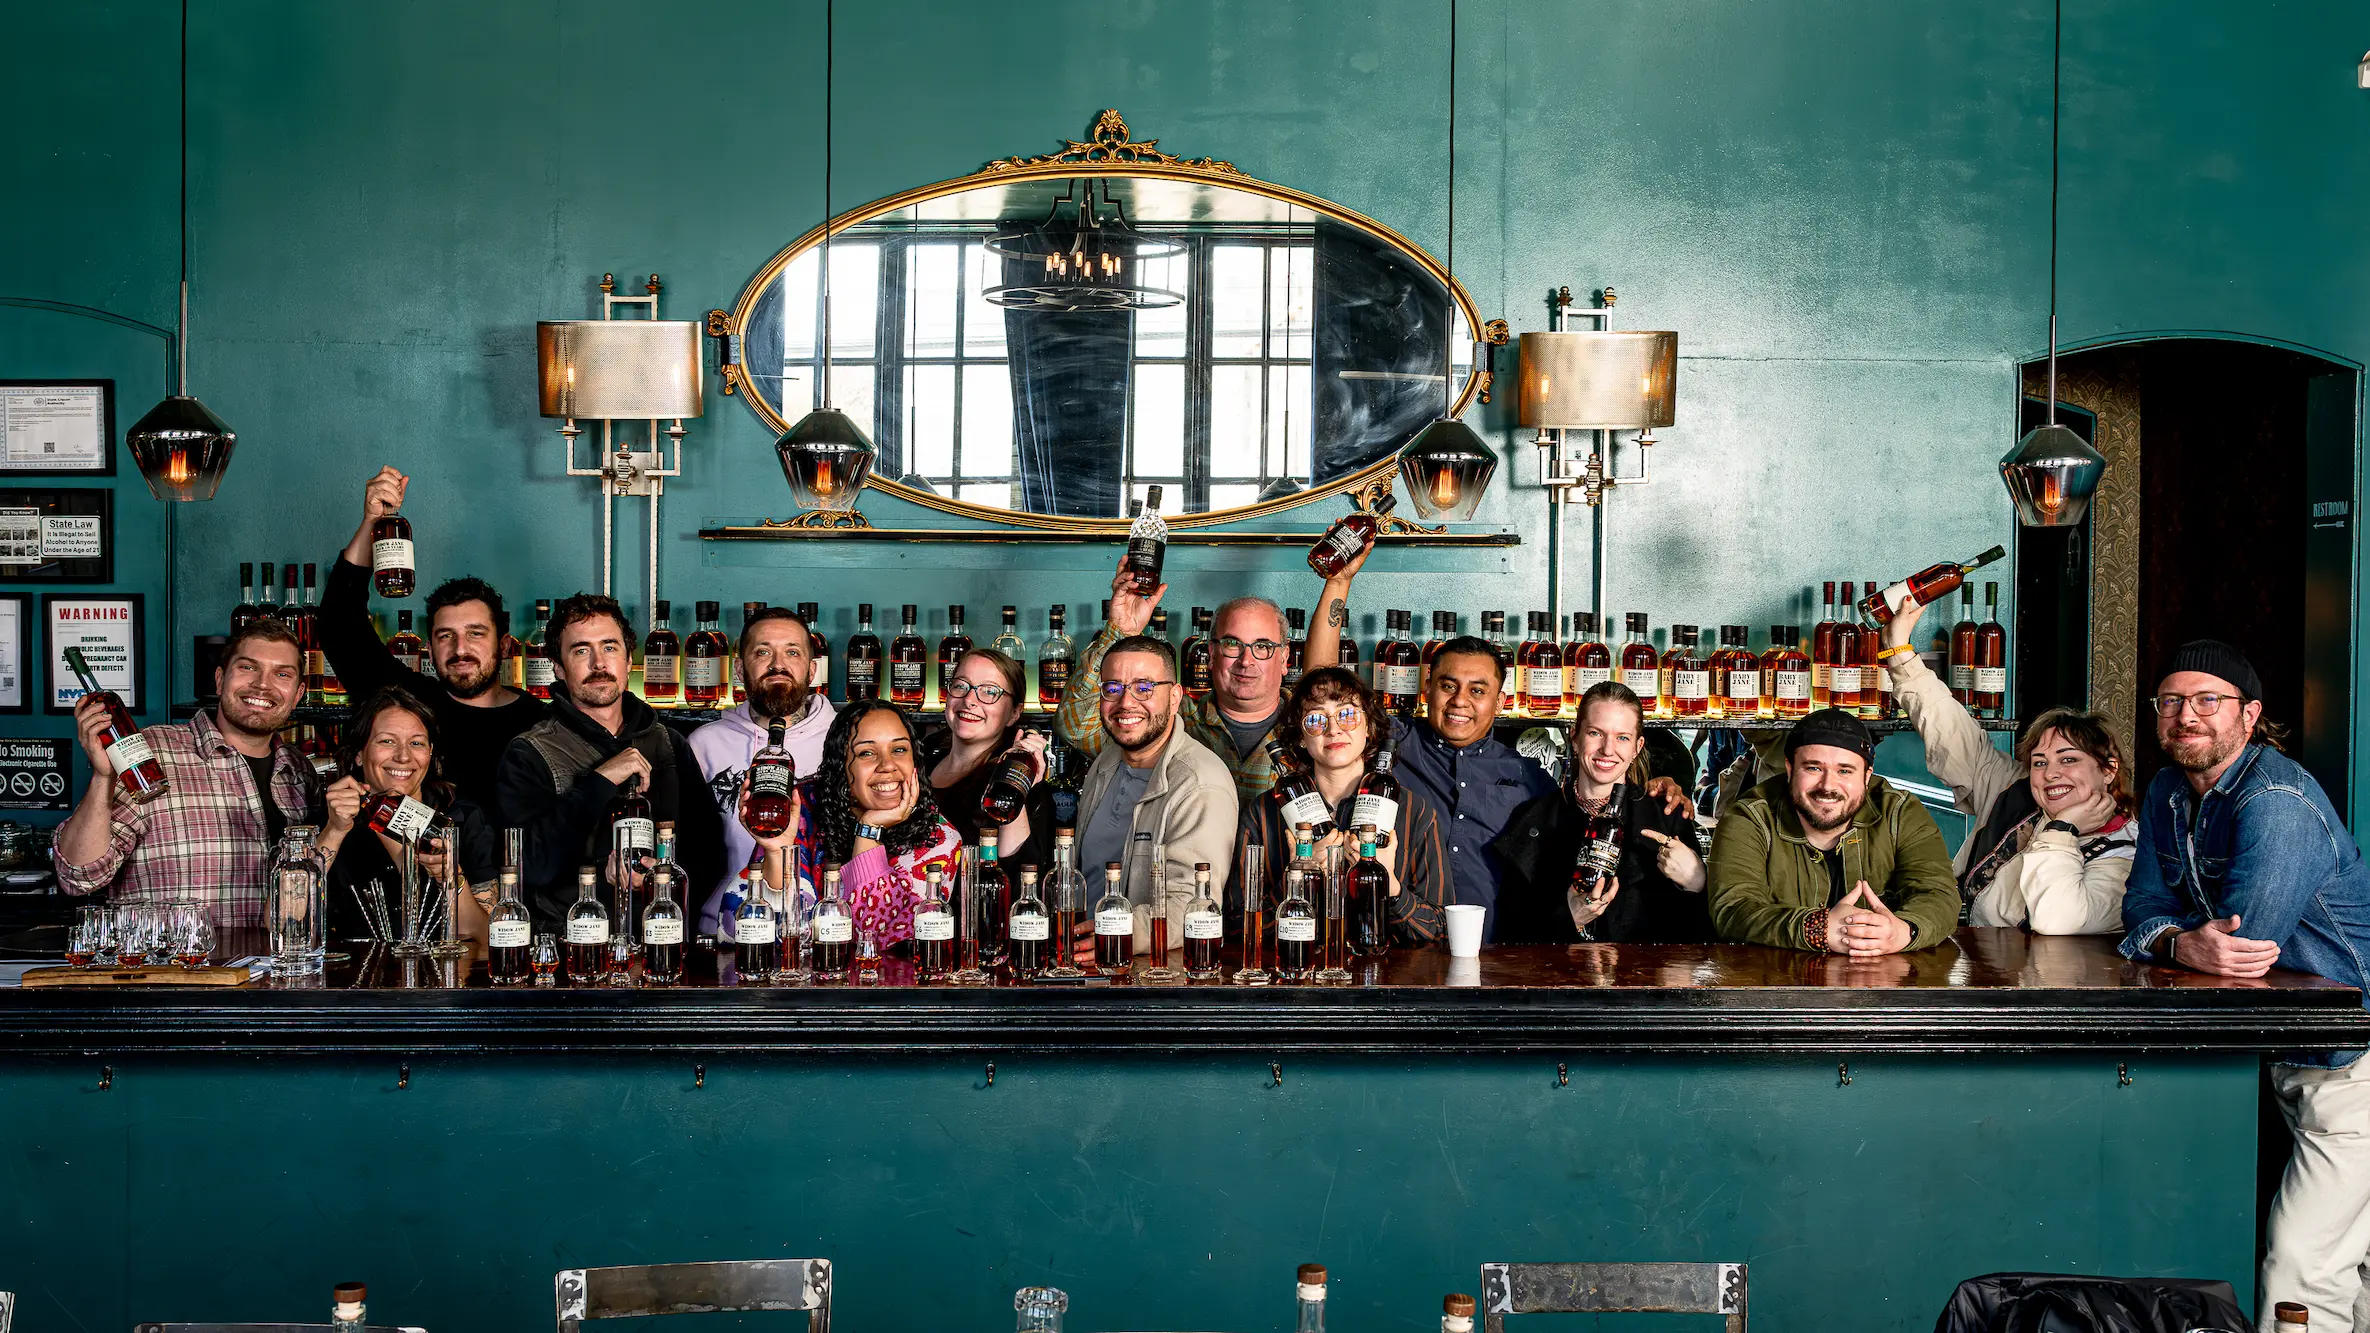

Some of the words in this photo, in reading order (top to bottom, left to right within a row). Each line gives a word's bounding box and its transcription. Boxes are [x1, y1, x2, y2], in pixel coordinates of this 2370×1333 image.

[2313, 500, 2348, 517] RESTROOM
[50, 520, 72, 528] State
[75, 520, 93, 528] Law
[59, 608, 128, 620] WARNING
[0, 745, 8, 756] o
[10, 744, 54, 759] Smoking
[391, 811, 407, 830] BABY
